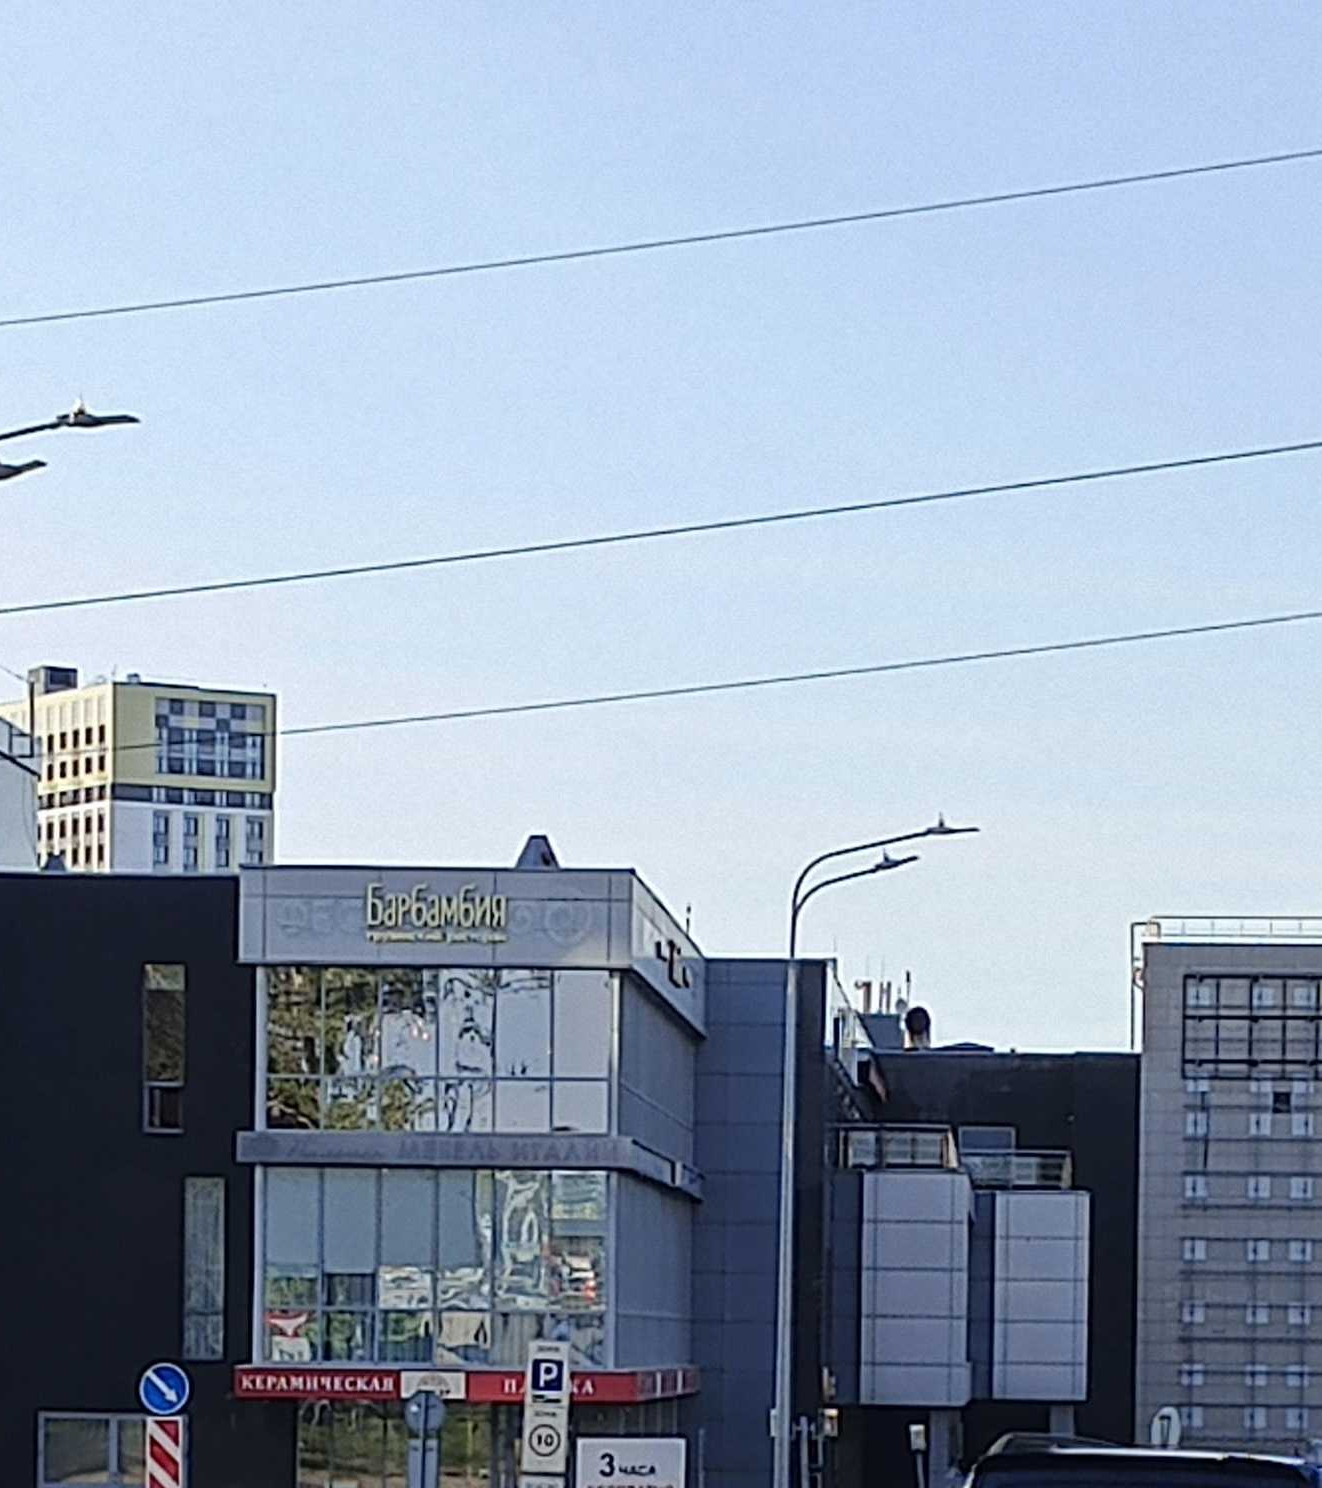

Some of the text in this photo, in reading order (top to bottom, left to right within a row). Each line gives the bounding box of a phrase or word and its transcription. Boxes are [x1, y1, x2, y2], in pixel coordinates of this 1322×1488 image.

[366, 882, 508, 928] Барбамбия
[241, 1374, 395, 1392] КЕРАМИЧЕСКАЯ
[538, 1361, 559, 1388] P
[599, 1452, 615, 1477] 3
